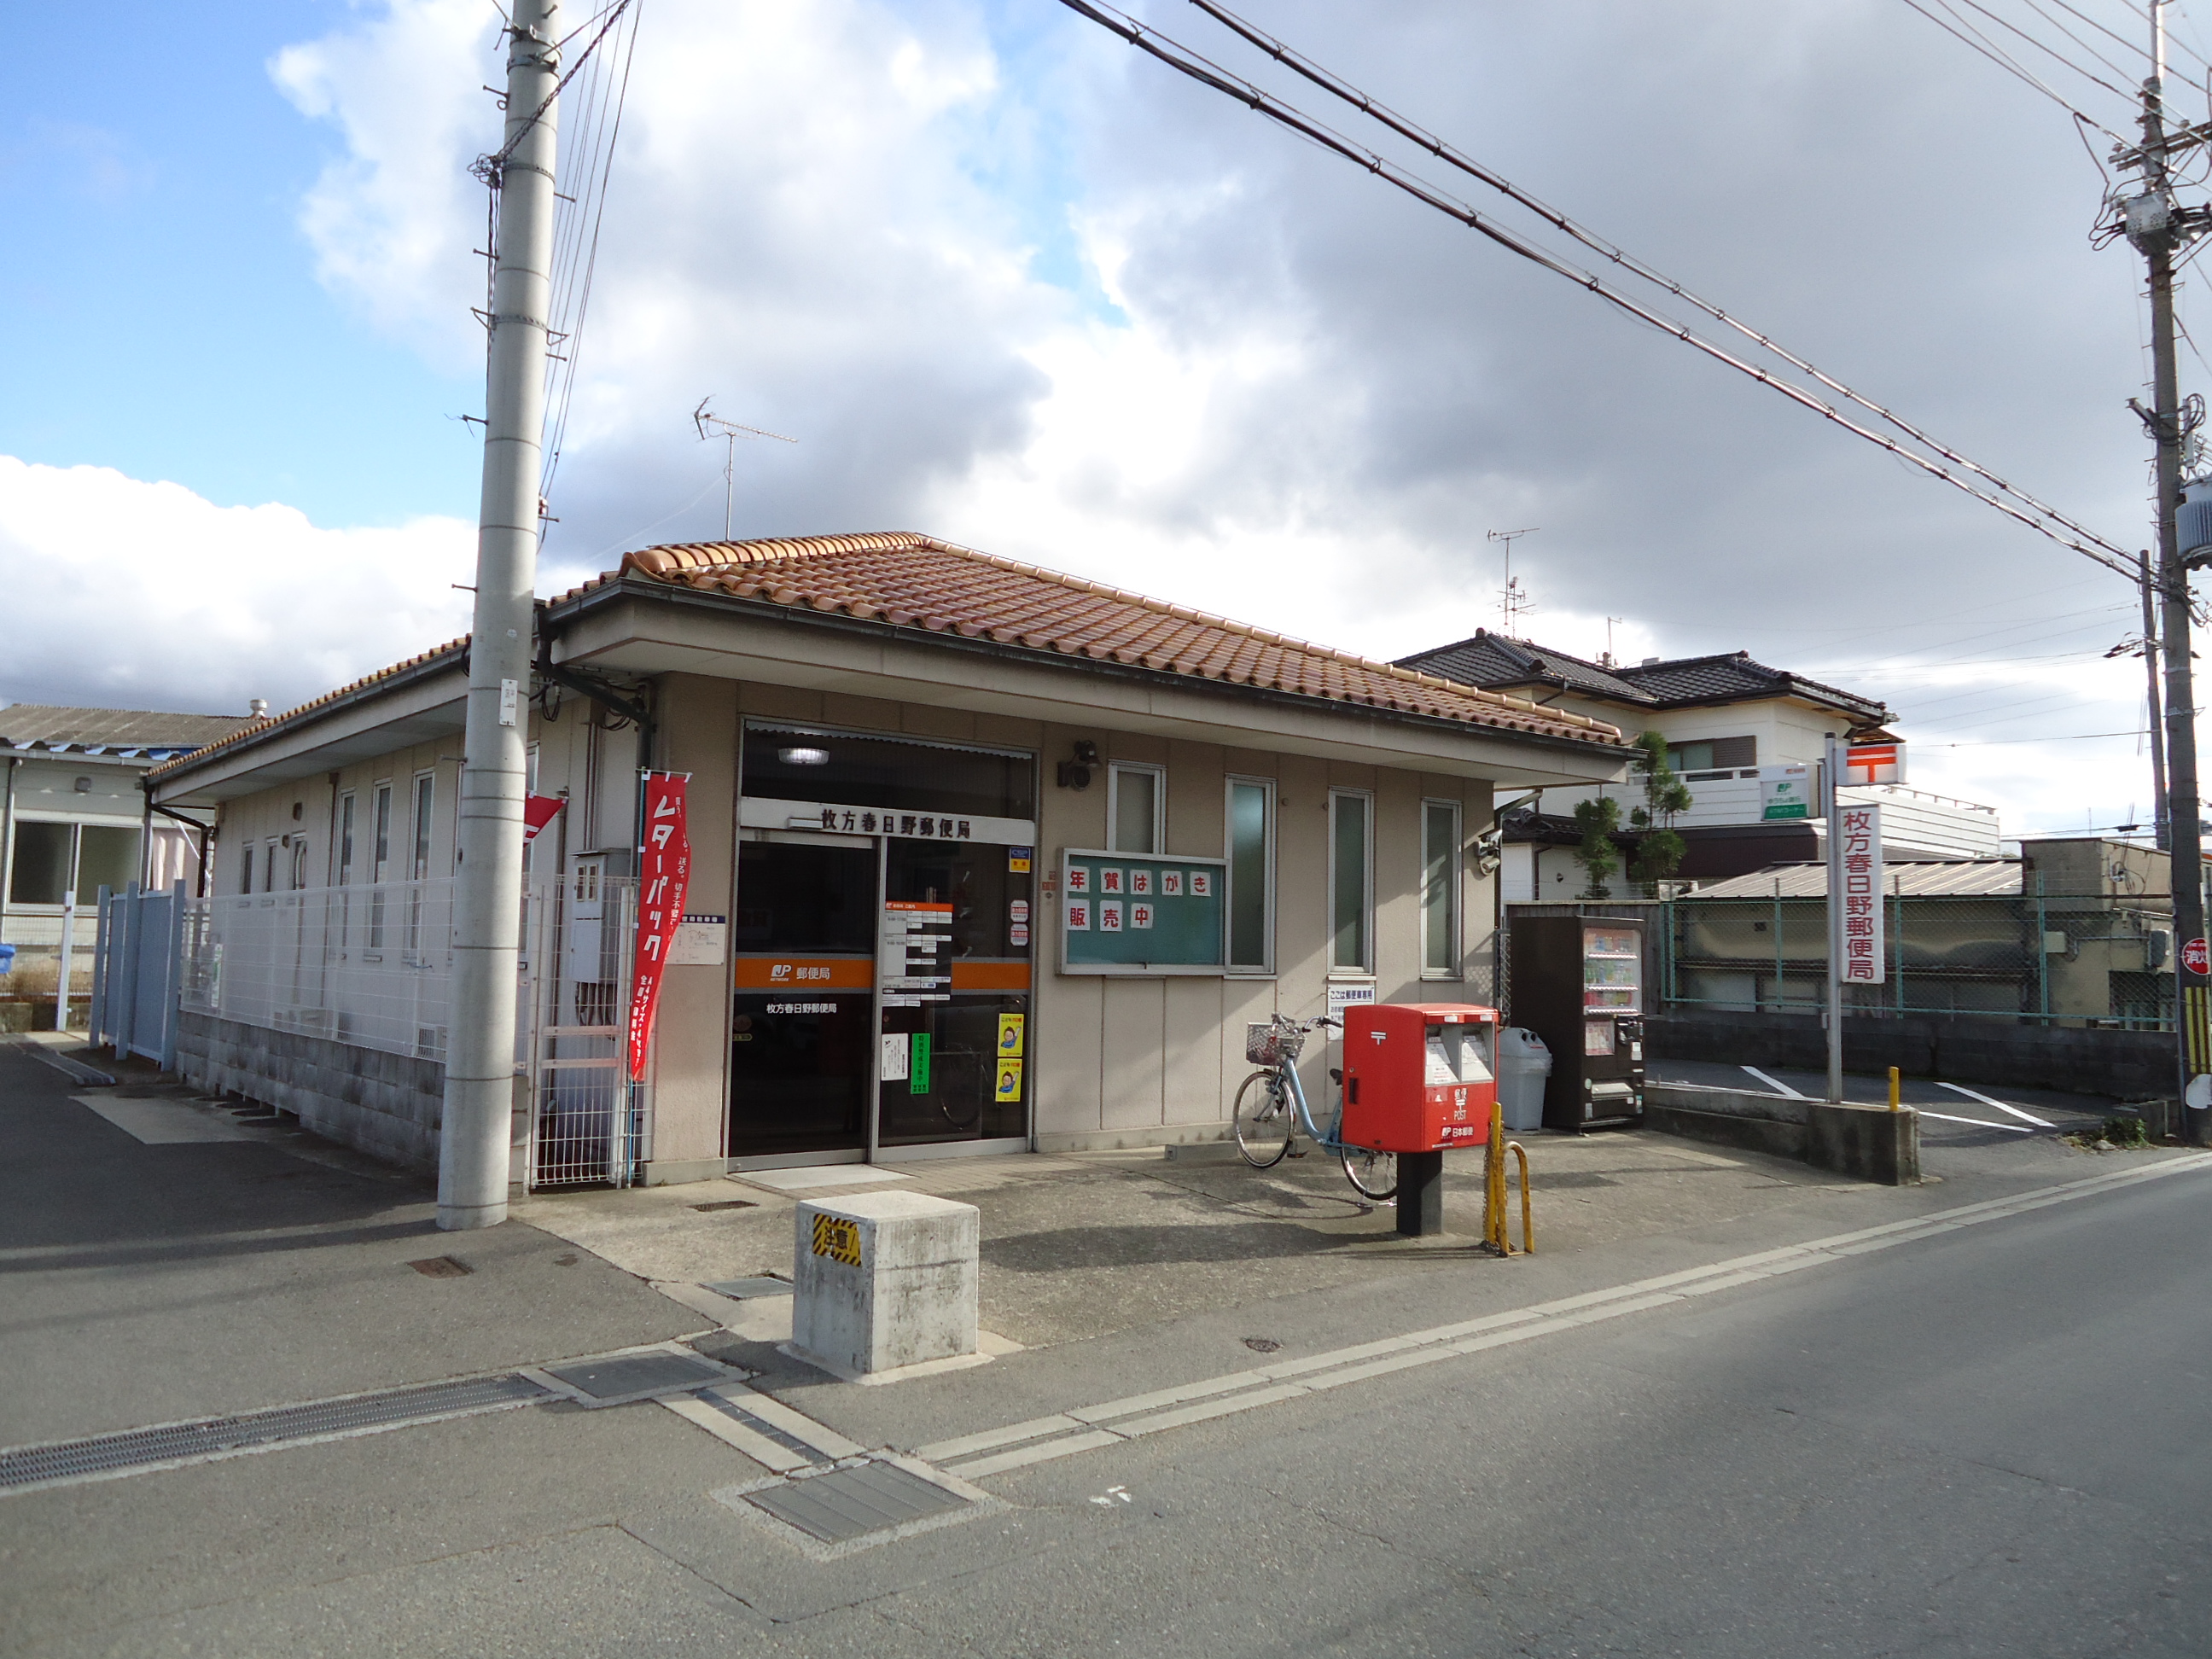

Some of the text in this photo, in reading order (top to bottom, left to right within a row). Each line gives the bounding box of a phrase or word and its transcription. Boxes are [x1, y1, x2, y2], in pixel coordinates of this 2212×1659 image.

[821, 809, 971, 839] 枚方春日野郵便局
[643, 795, 676, 962] レターパック
[1069, 870, 1207, 894] 年賀はがき
[1843, 811, 1874, 981] 枚方春日野郵便局
[1069, 907, 1150, 928] 販売中
[2185, 949, 2209, 964] 消火
[771, 964, 830, 980] JP 郵便局
[766, 1003, 837, 1014] 枚方春日野郵便局
[1454, 1087, 1468, 1100] 郵便
[1453, 1109, 1467, 1121] POST
[1452, 1126, 1474, 1138] 日本郵便
